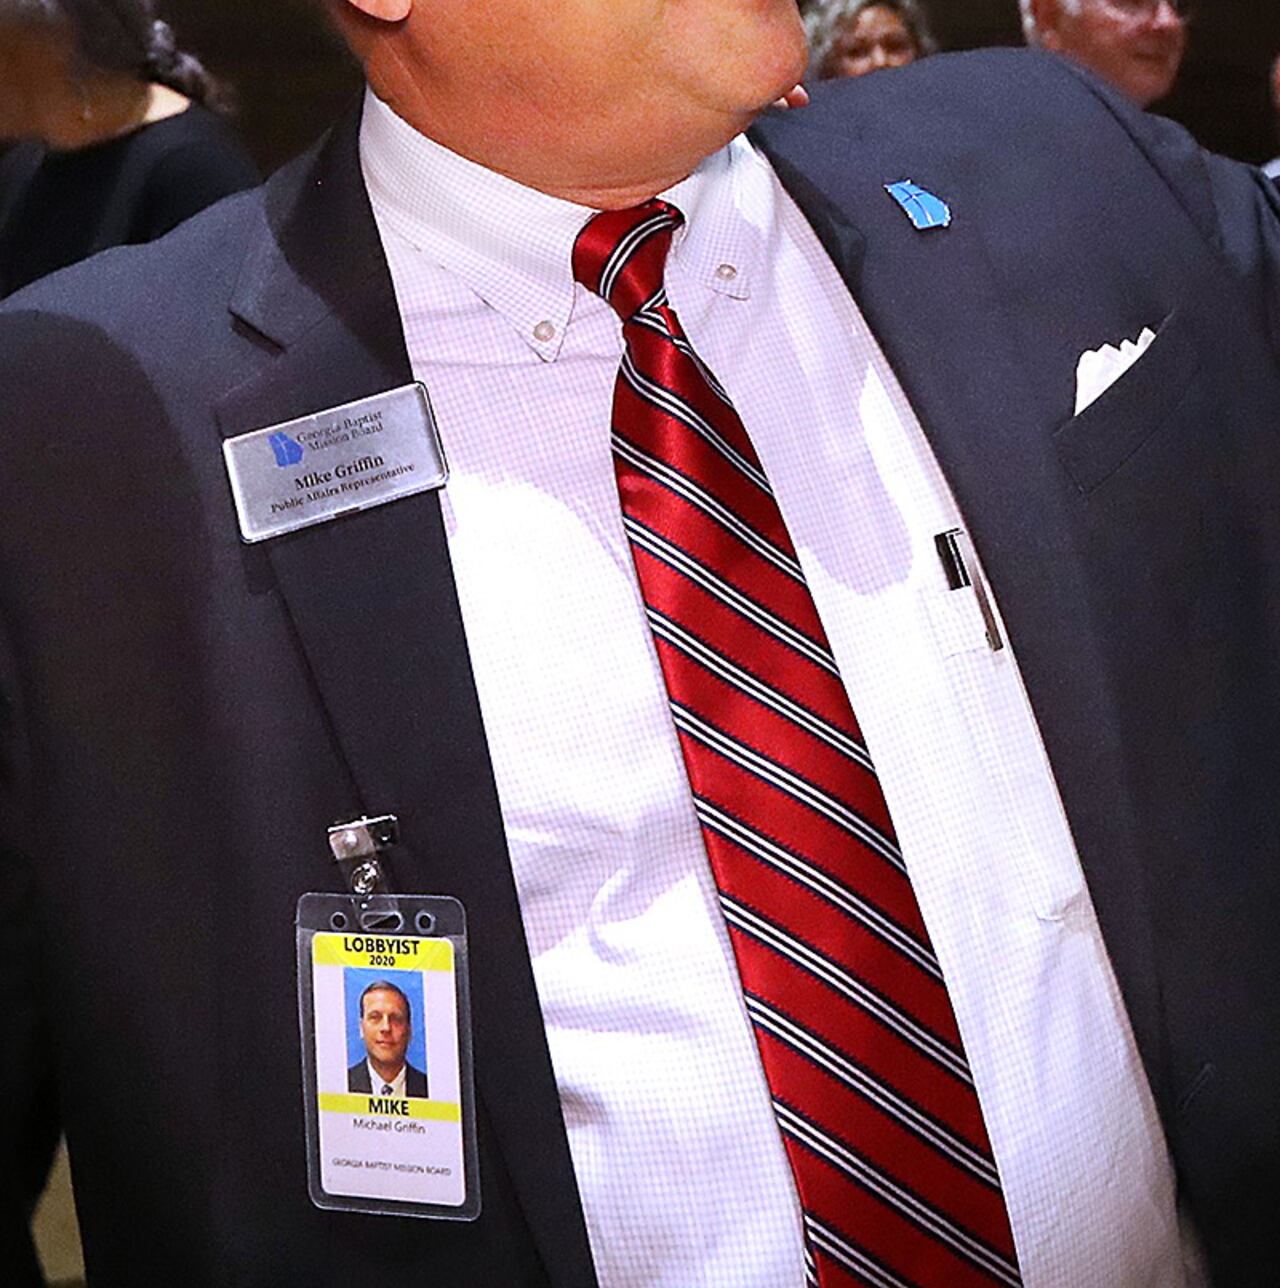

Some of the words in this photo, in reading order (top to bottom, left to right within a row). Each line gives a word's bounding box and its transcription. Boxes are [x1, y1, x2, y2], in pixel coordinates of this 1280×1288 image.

[297, 424, 341, 443] Georgia
[344, 411, 383, 430] Baptist
[352, 422, 383, 439] Board
[295, 469, 332, 491] Mike
[335, 455, 385, 478] Griffin
[271, 496, 304, 513] Public
[307, 487, 340, 503] Affairs
[340, 464, 415, 492] Representative
[344, 936, 420, 955] LOBBYIST
[370, 955, 395, 967] 2020
[368, 1098, 410, 1116] MIKE
[353, 1118, 393, 1132] Michael
[394, 1120, 426, 1134] Griffin
